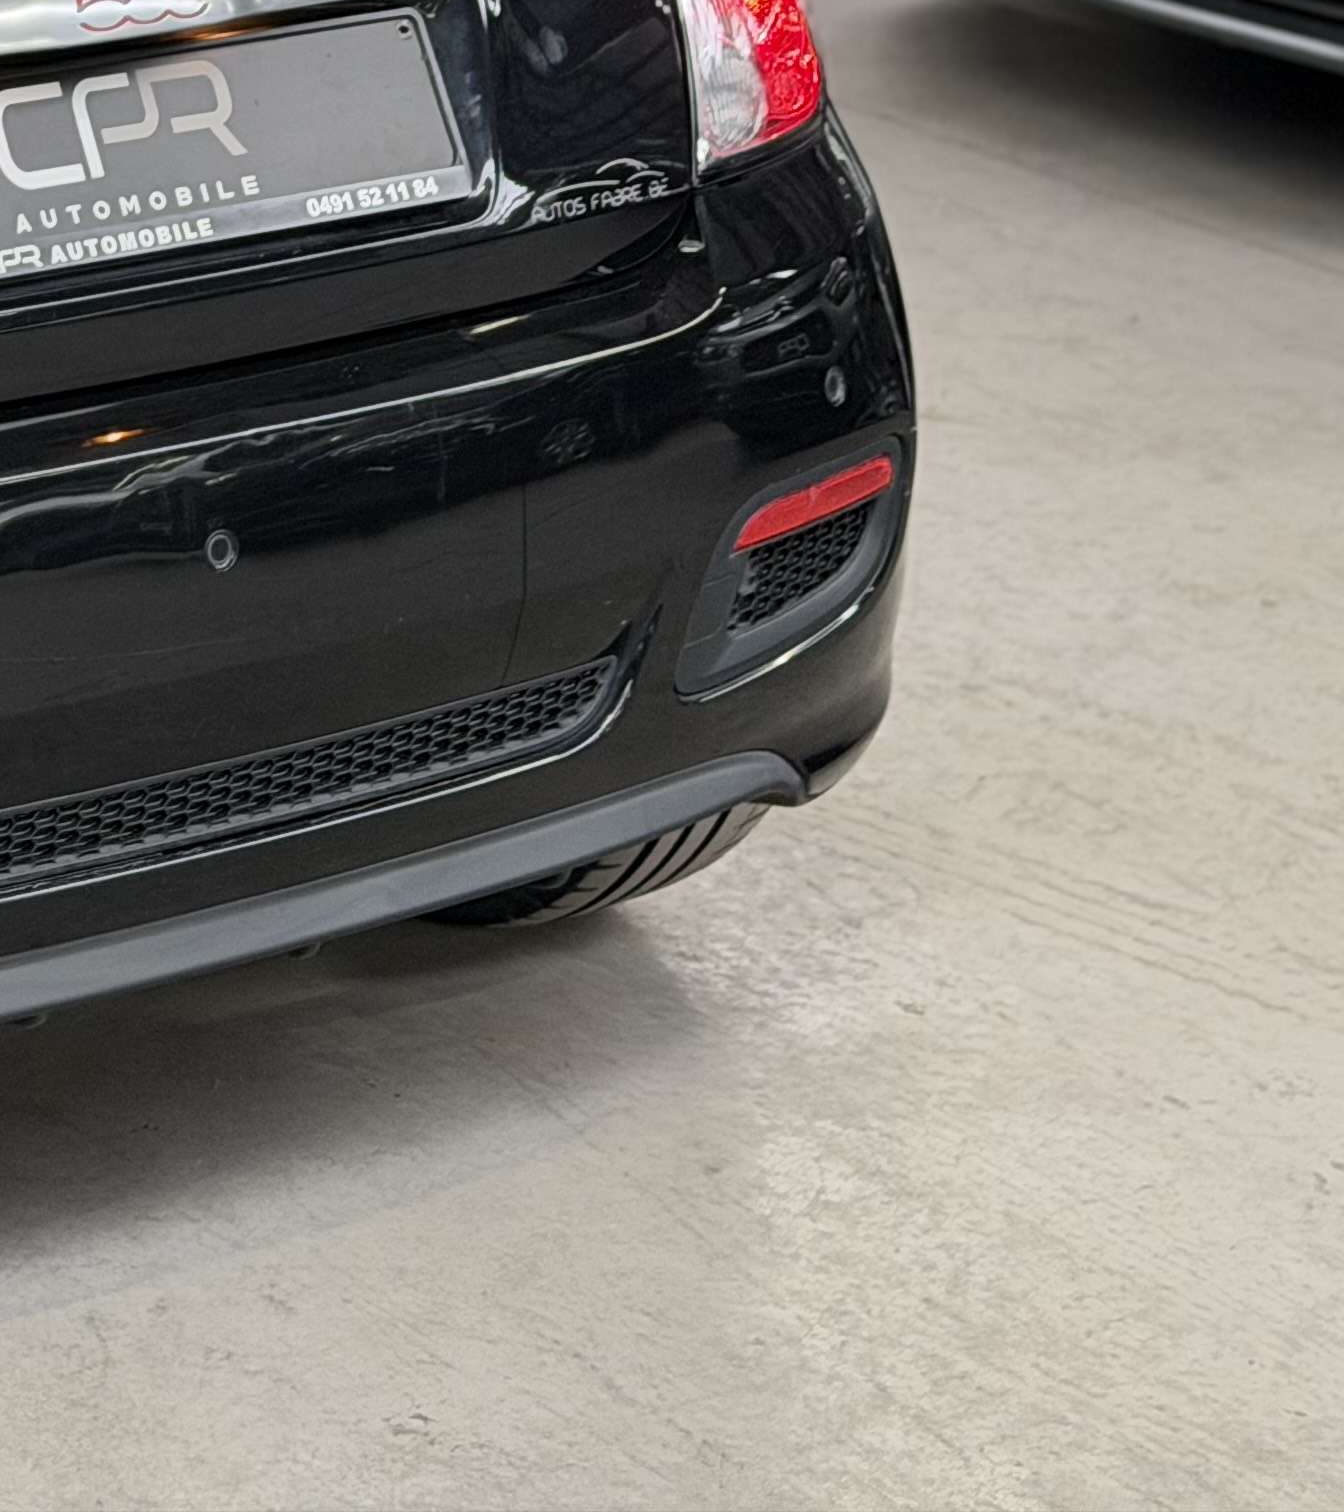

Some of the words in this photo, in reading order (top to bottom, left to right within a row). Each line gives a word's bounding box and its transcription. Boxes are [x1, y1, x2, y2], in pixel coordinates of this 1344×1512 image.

[16, 175, 260, 234] AUTOMOBILE
[305, 191, 354, 217] 0491
[356, 186, 385, 208] 52
[385, 181, 410, 202] 11
[412, 175, 439, 198] 84
[530, 196, 587, 225] AUTOS
[50, 217, 214, 265] AUTOMOBILE
